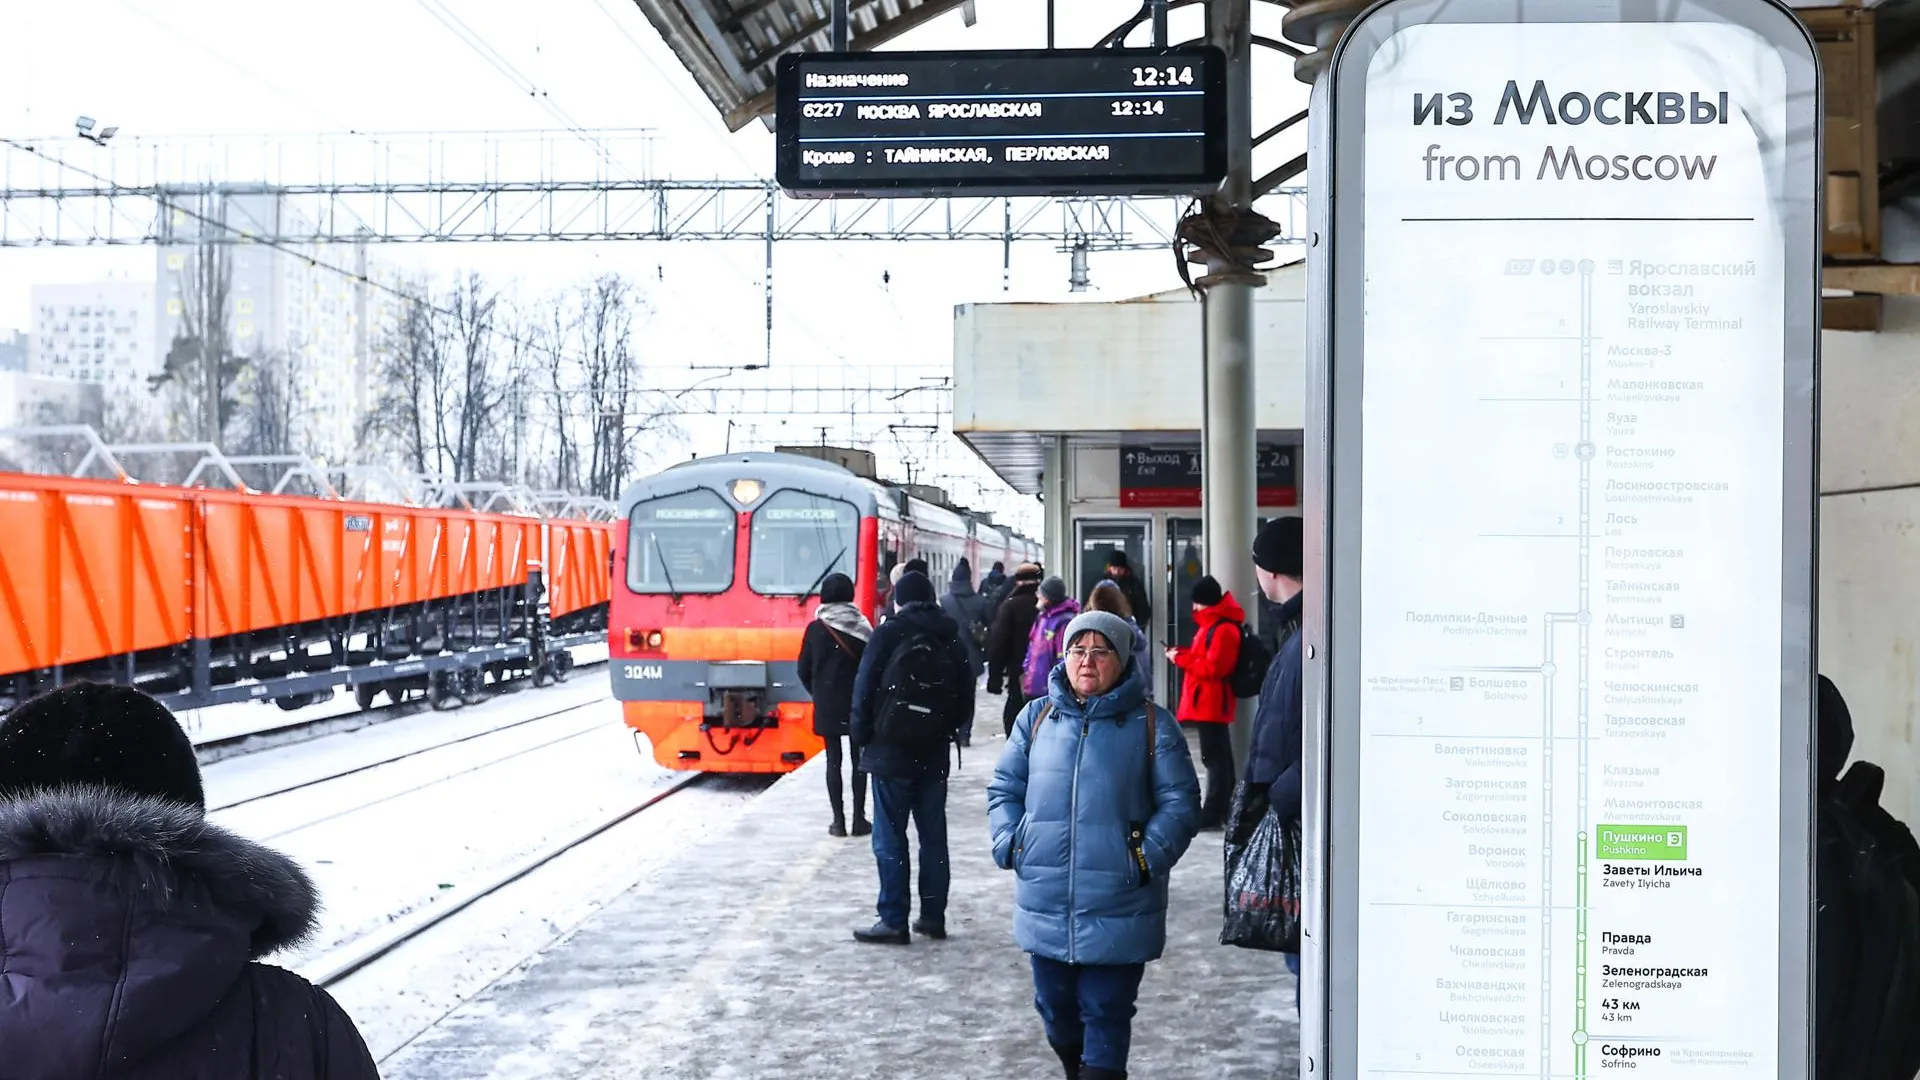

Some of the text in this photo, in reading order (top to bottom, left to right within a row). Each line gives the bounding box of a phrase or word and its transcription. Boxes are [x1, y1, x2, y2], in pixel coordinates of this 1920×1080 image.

[806, 72, 909, 88] Назначение
[1132, 67, 1194, 86] 12:14
[803, 100, 1165, 119] 6227 МОСКВА ЯРОСЛАВСКАЯ 12:14
[1413, 80, 1728, 126] из Москвы
[803, 151, 854, 166] Кроме
[885, 145, 993, 164] ТАЙНИНСКАЯ,
[1006, 145, 1110, 162] ПЕРЛОВСКАЯ
[1422, 144, 1718, 180] from Moscow
[1629, 259, 1756, 278] Ярославский
[1628, 284, 1694, 297] вокзал
[1629, 302, 1709, 317] Yaroslavskiy
[1628, 317, 1742, 332] Railway Terminal
[1607, 345, 1672, 356] Москва-3
[1607, 379, 1704, 391] Маленковская
[1607, 412, 1638, 425] Яуза
[1606, 446, 1675, 458] Ростокино
[1137, 453, 1181, 466] Выход
[1606, 460, 1654, 469] Rostokino
[1137, 466, 1157, 475] Exit
[1606, 479, 1729, 493] Лосиноостровская
[1606, 513, 1638, 526] Лось
[1605, 547, 1683, 561] Перловская
[1606, 580, 1680, 592] Тайнинская
[1406, 612, 1528, 626] Подлипки-Дачные
[1605, 613, 1664, 627] Мытищи
[1605, 647, 1675, 660] Строитель
[624, 665, 663, 679] ЭД4М
[1469, 678, 1528, 689] Болшево
[1605, 681, 1699, 693] Челюскинская
[1484, 691, 1528, 701] Bolshevo
[1605, 714, 1686, 727] Тарасовская
[1434, 743, 1528, 755] Валентиновка
[1604, 764, 1661, 777] Клязьма
[1445, 777, 1528, 790] Загорянская
[1604, 798, 1704, 810] Мамонтовская
[1442, 810, 1528, 822] Соколовская
[1604, 811, 1682, 822] Mamontovskaya
[1463, 825, 1528, 836] Sokolovskaya
[1603, 831, 1664, 844] Пушкино
[1468, 844, 1526, 857] Воронок
[1602, 845, 1647, 855] Pushkino
[1485, 859, 1526, 868] Voronok
[1603, 864, 1703, 877] Заветы Ильича
[1466, 878, 1526, 890] Щёлково
[1603, 878, 1671, 890] Zavety Ilyicha
[1446, 911, 1527, 924] Гагаринская
[1462, 926, 1526, 936] Gagarinskaya
[1602, 932, 1652, 945] Правда
[1450, 945, 1526, 957] Чкаловская
[1602, 946, 1635, 955] Pravda
[1602, 964, 1709, 978] Зеленоградская
[1436, 978, 1526, 991] Бахчиванджи
[1602, 979, 1682, 991] Zelenogradskaya
[1602, 998, 1641, 1010] 43 км
[1439, 1011, 1526, 1024] Циолковская
[1602, 1013, 1633, 1022] 43 km
[1455, 1045, 1526, 1057] Осеевская
[1601, 1044, 1662, 1058] Софрино
[1469, 1060, 1525, 1070] Oseevskaya
[1601, 1059, 1637, 1068] Sofrino
